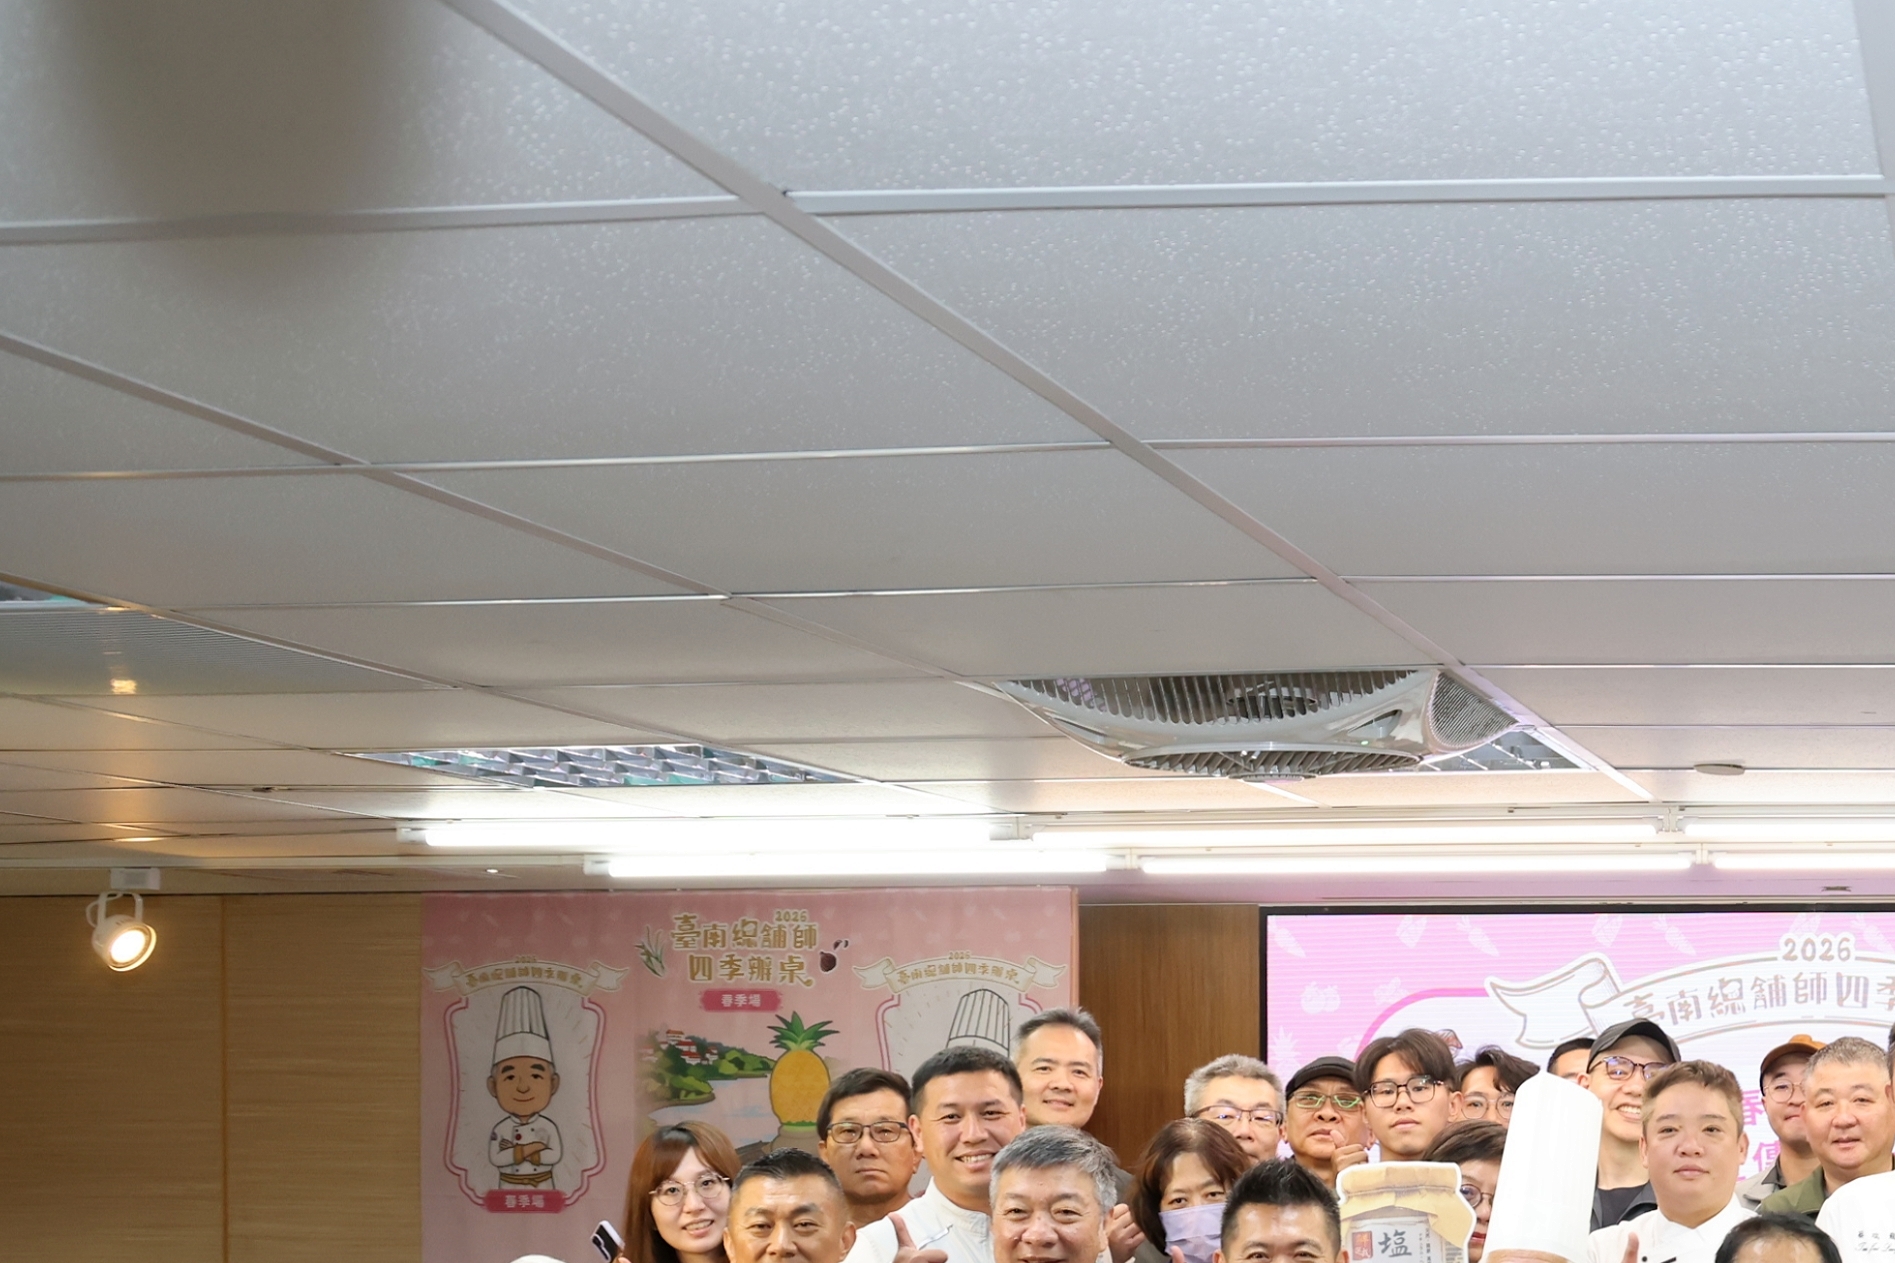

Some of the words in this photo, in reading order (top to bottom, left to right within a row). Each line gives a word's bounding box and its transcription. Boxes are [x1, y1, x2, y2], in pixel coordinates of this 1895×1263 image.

[775, 911, 807, 922] 2026
[1782, 937, 1852, 961] 2026
[689, 953, 813, 987] 四季辦桌
